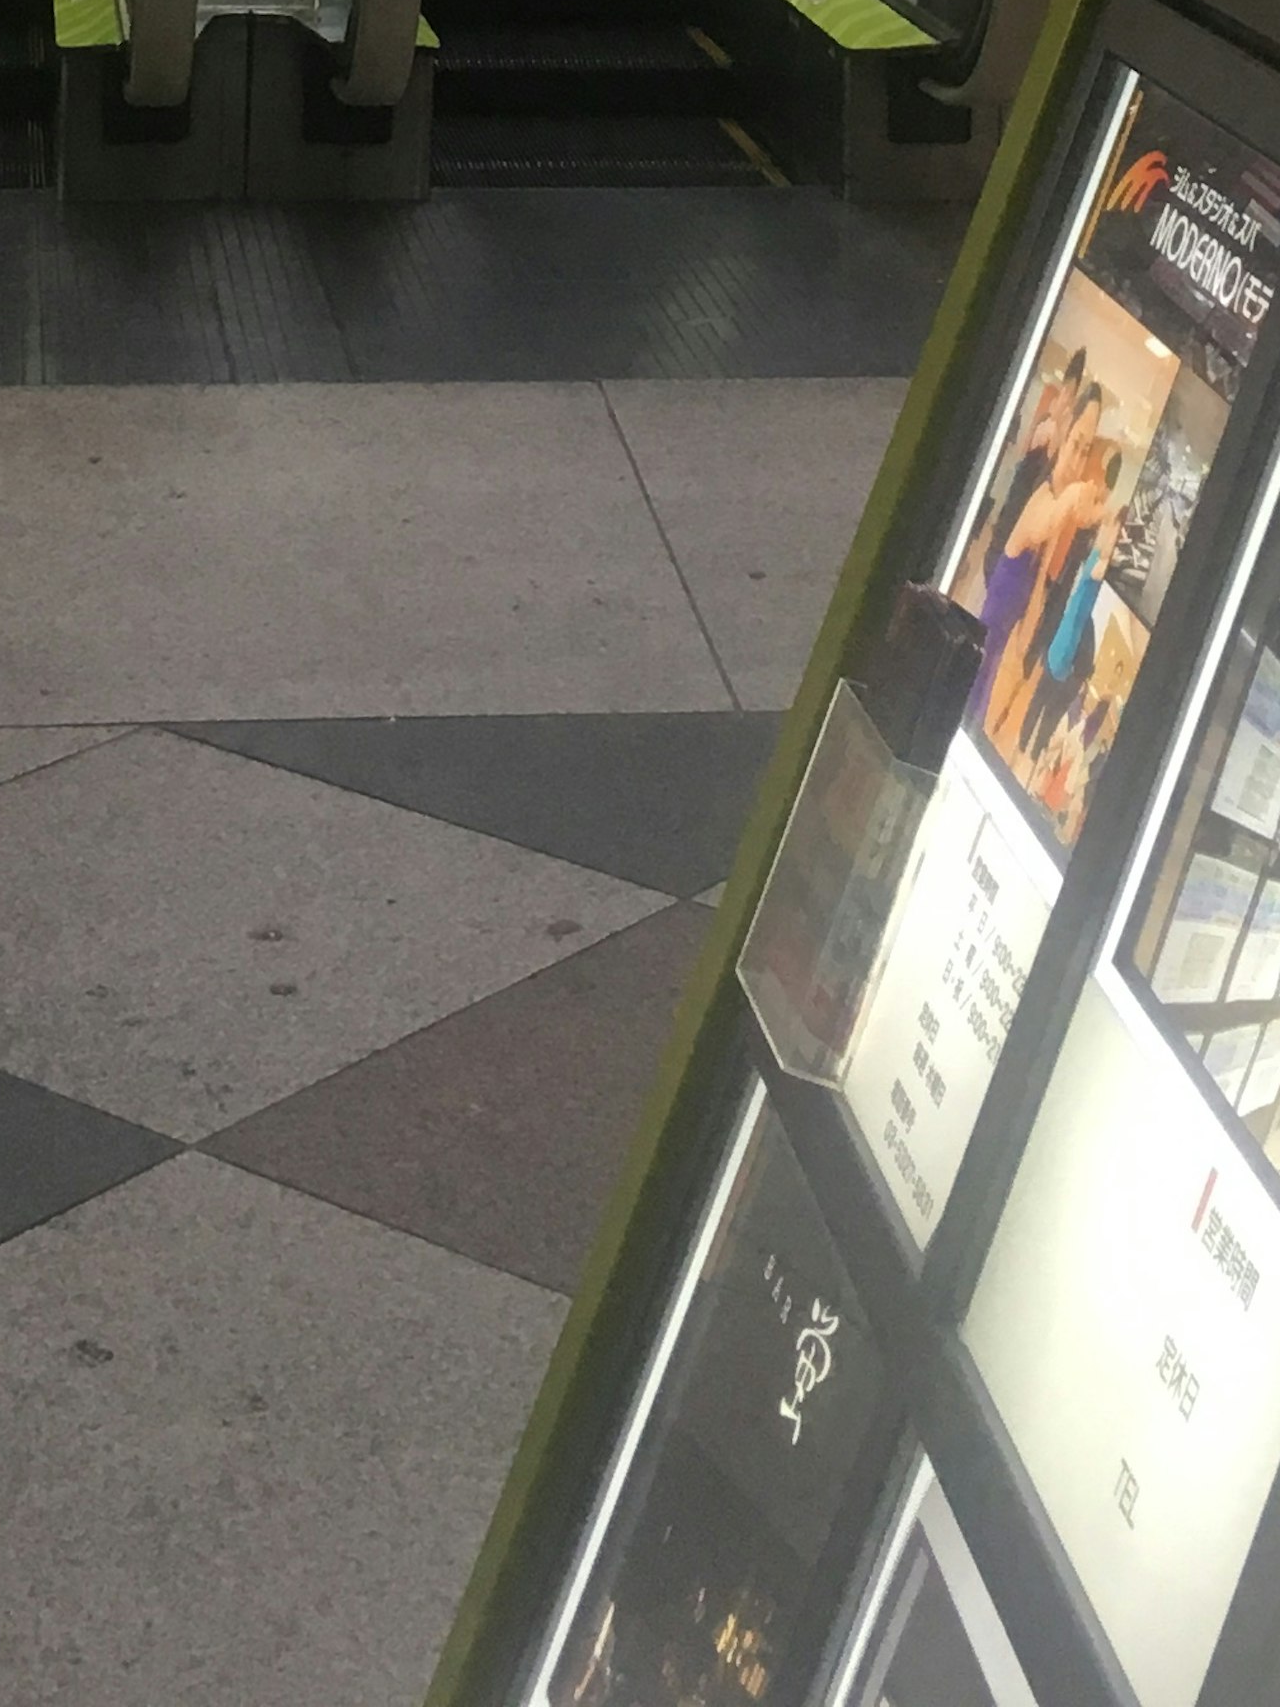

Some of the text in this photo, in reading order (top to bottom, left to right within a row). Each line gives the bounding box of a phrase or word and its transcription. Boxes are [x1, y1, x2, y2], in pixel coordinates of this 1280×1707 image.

[1201, 1205, 1260, 1312] 営業時間
[1155, 1334, 1201, 1423] 定休日
[1114, 1457, 1140, 1530] TEL
